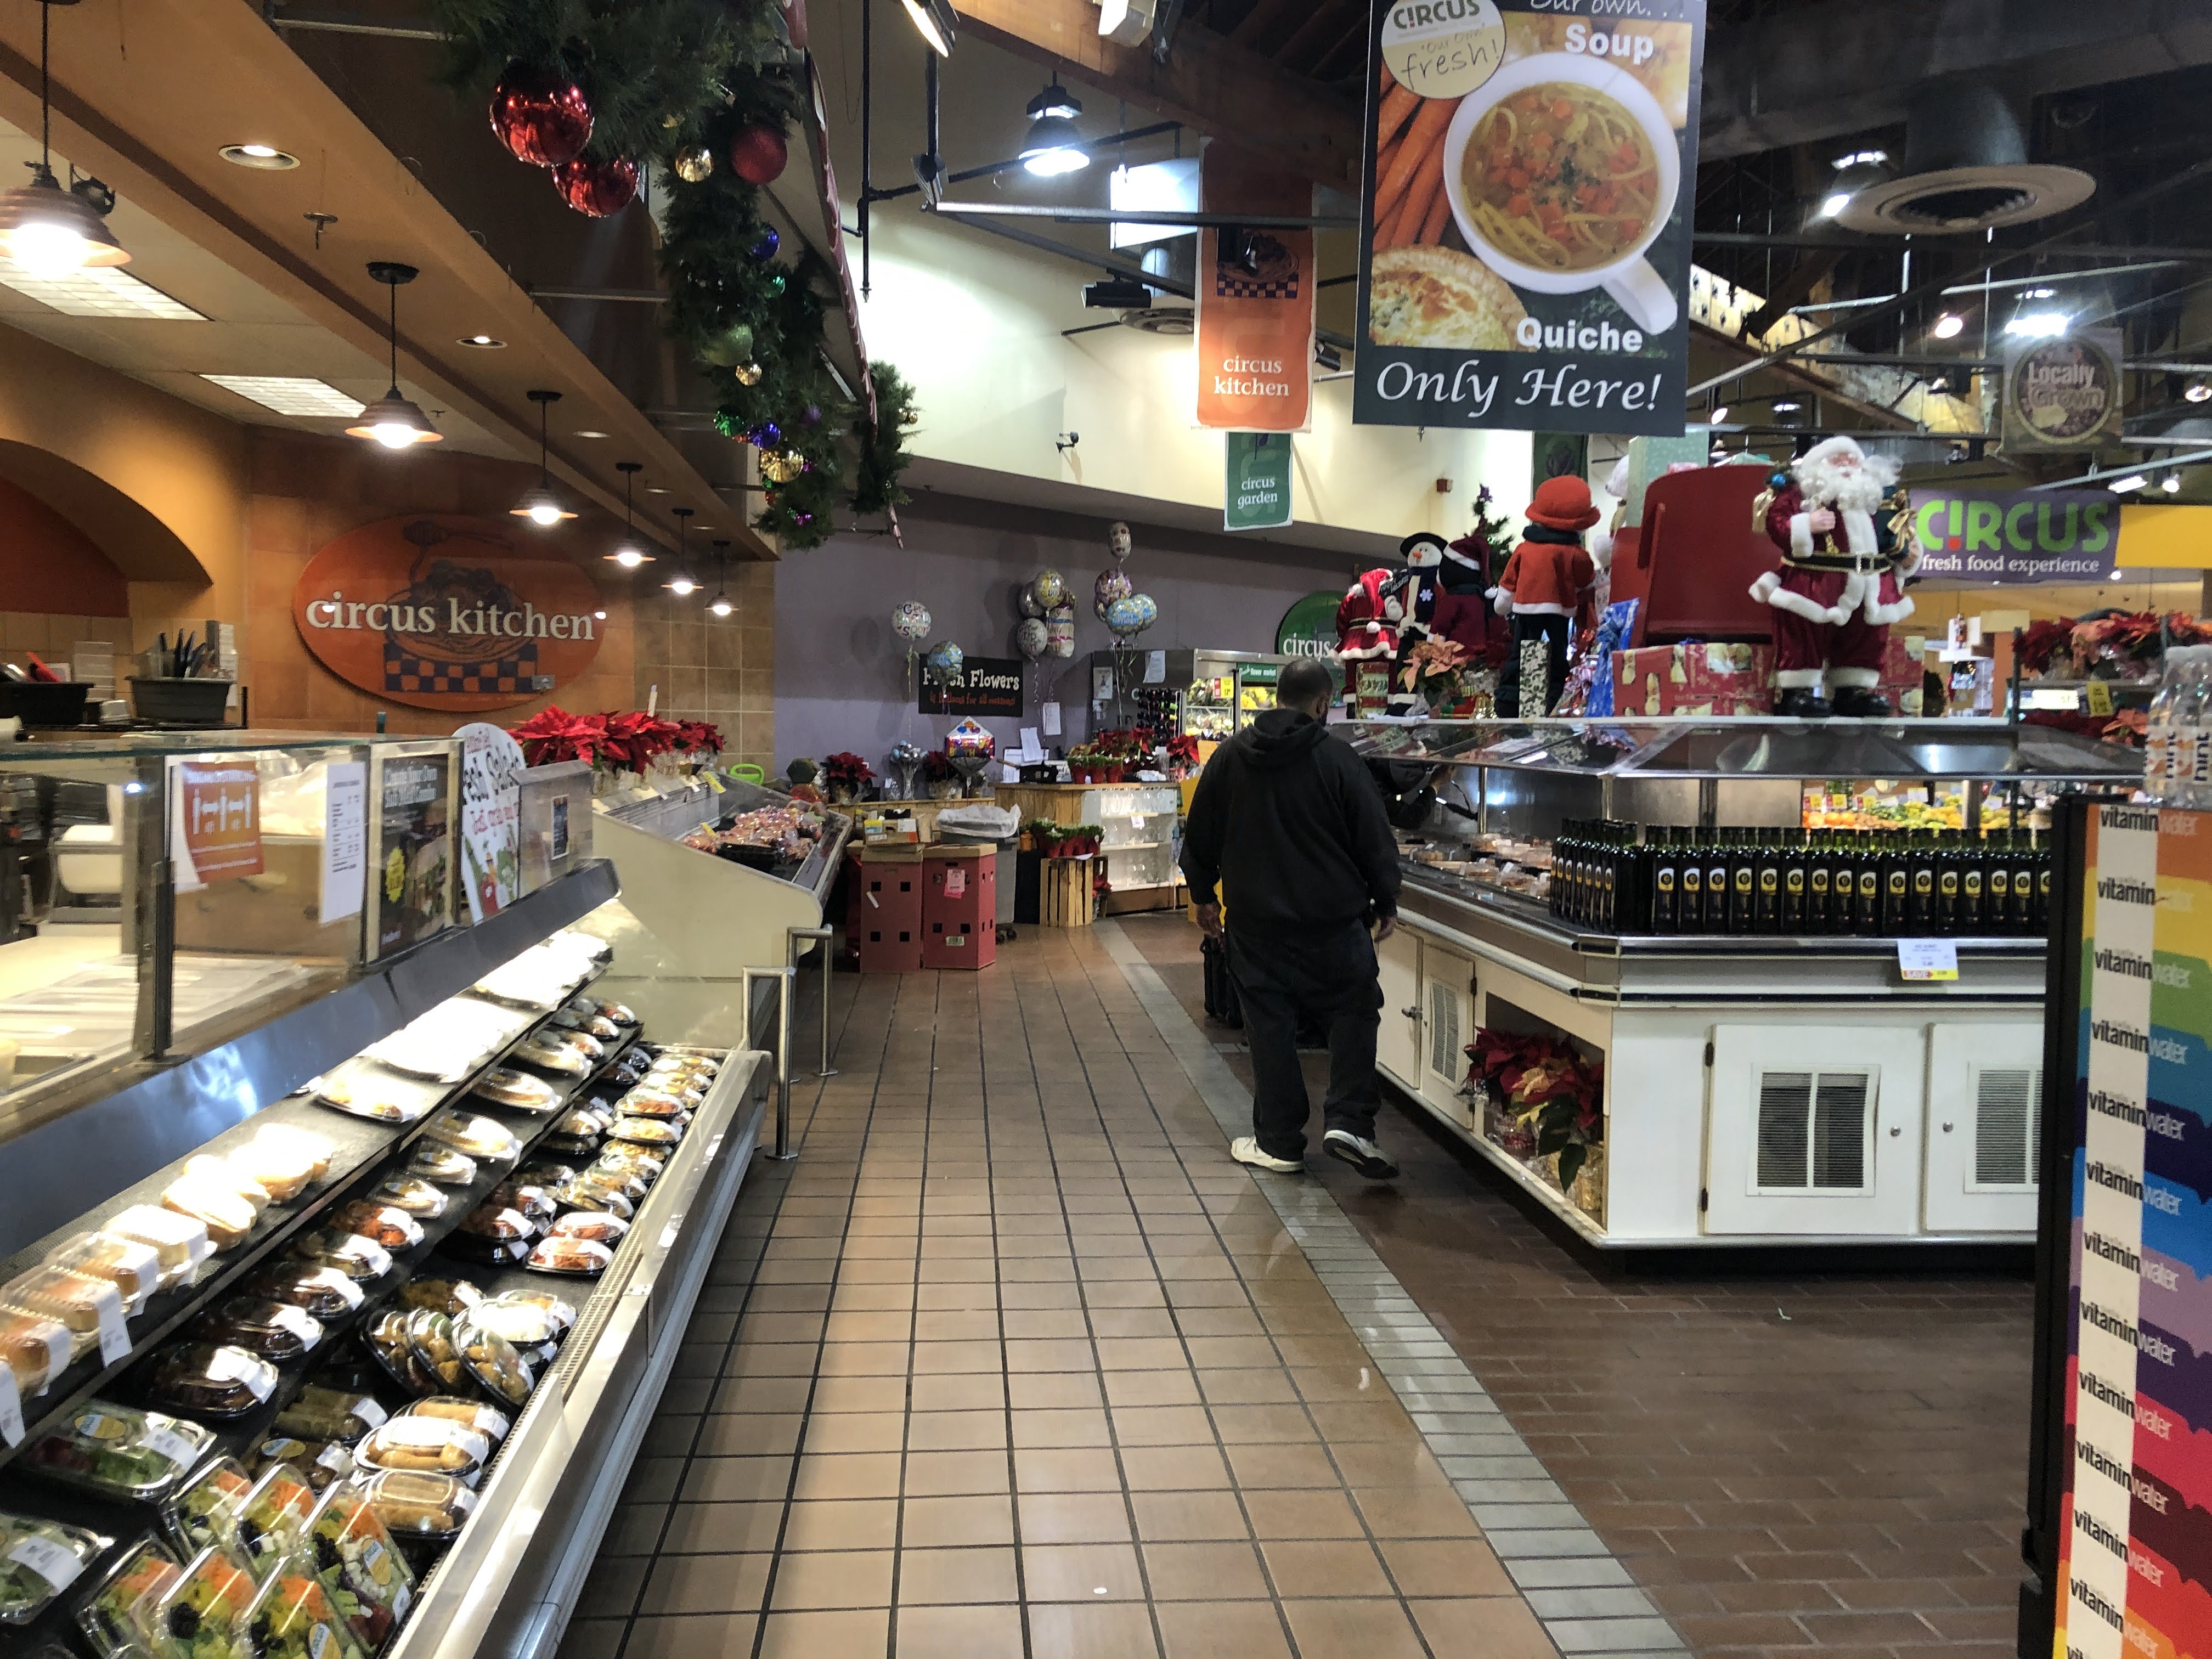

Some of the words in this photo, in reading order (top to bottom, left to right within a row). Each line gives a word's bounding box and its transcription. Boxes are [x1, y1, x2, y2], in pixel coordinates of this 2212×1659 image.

[1565, 24, 1654, 65] Soup
[1400, 39, 1500, 92] fresh!
[1516, 317, 1643, 353] Quiche
[1223, 355, 1282, 374] circus
[2028, 362, 2095, 388] Locally
[1214, 376, 1289, 397] kitchen
[1376, 359, 1499, 418] Only
[1515, 362, 1662, 411] Here!
[1241, 477, 1275, 491] circus
[1237, 490, 1278, 510] garden
[1922, 554, 1962, 572] fresh
[1967, 555, 2004, 572] food
[2008, 556, 2101, 576] experience
[306, 591, 436, 633] circus
[448, 597, 595, 640] kitchen
[1283, 633, 1330, 659] circus
[969, 668, 1020, 691] Flowers
[1263, 669, 1277, 677] market
